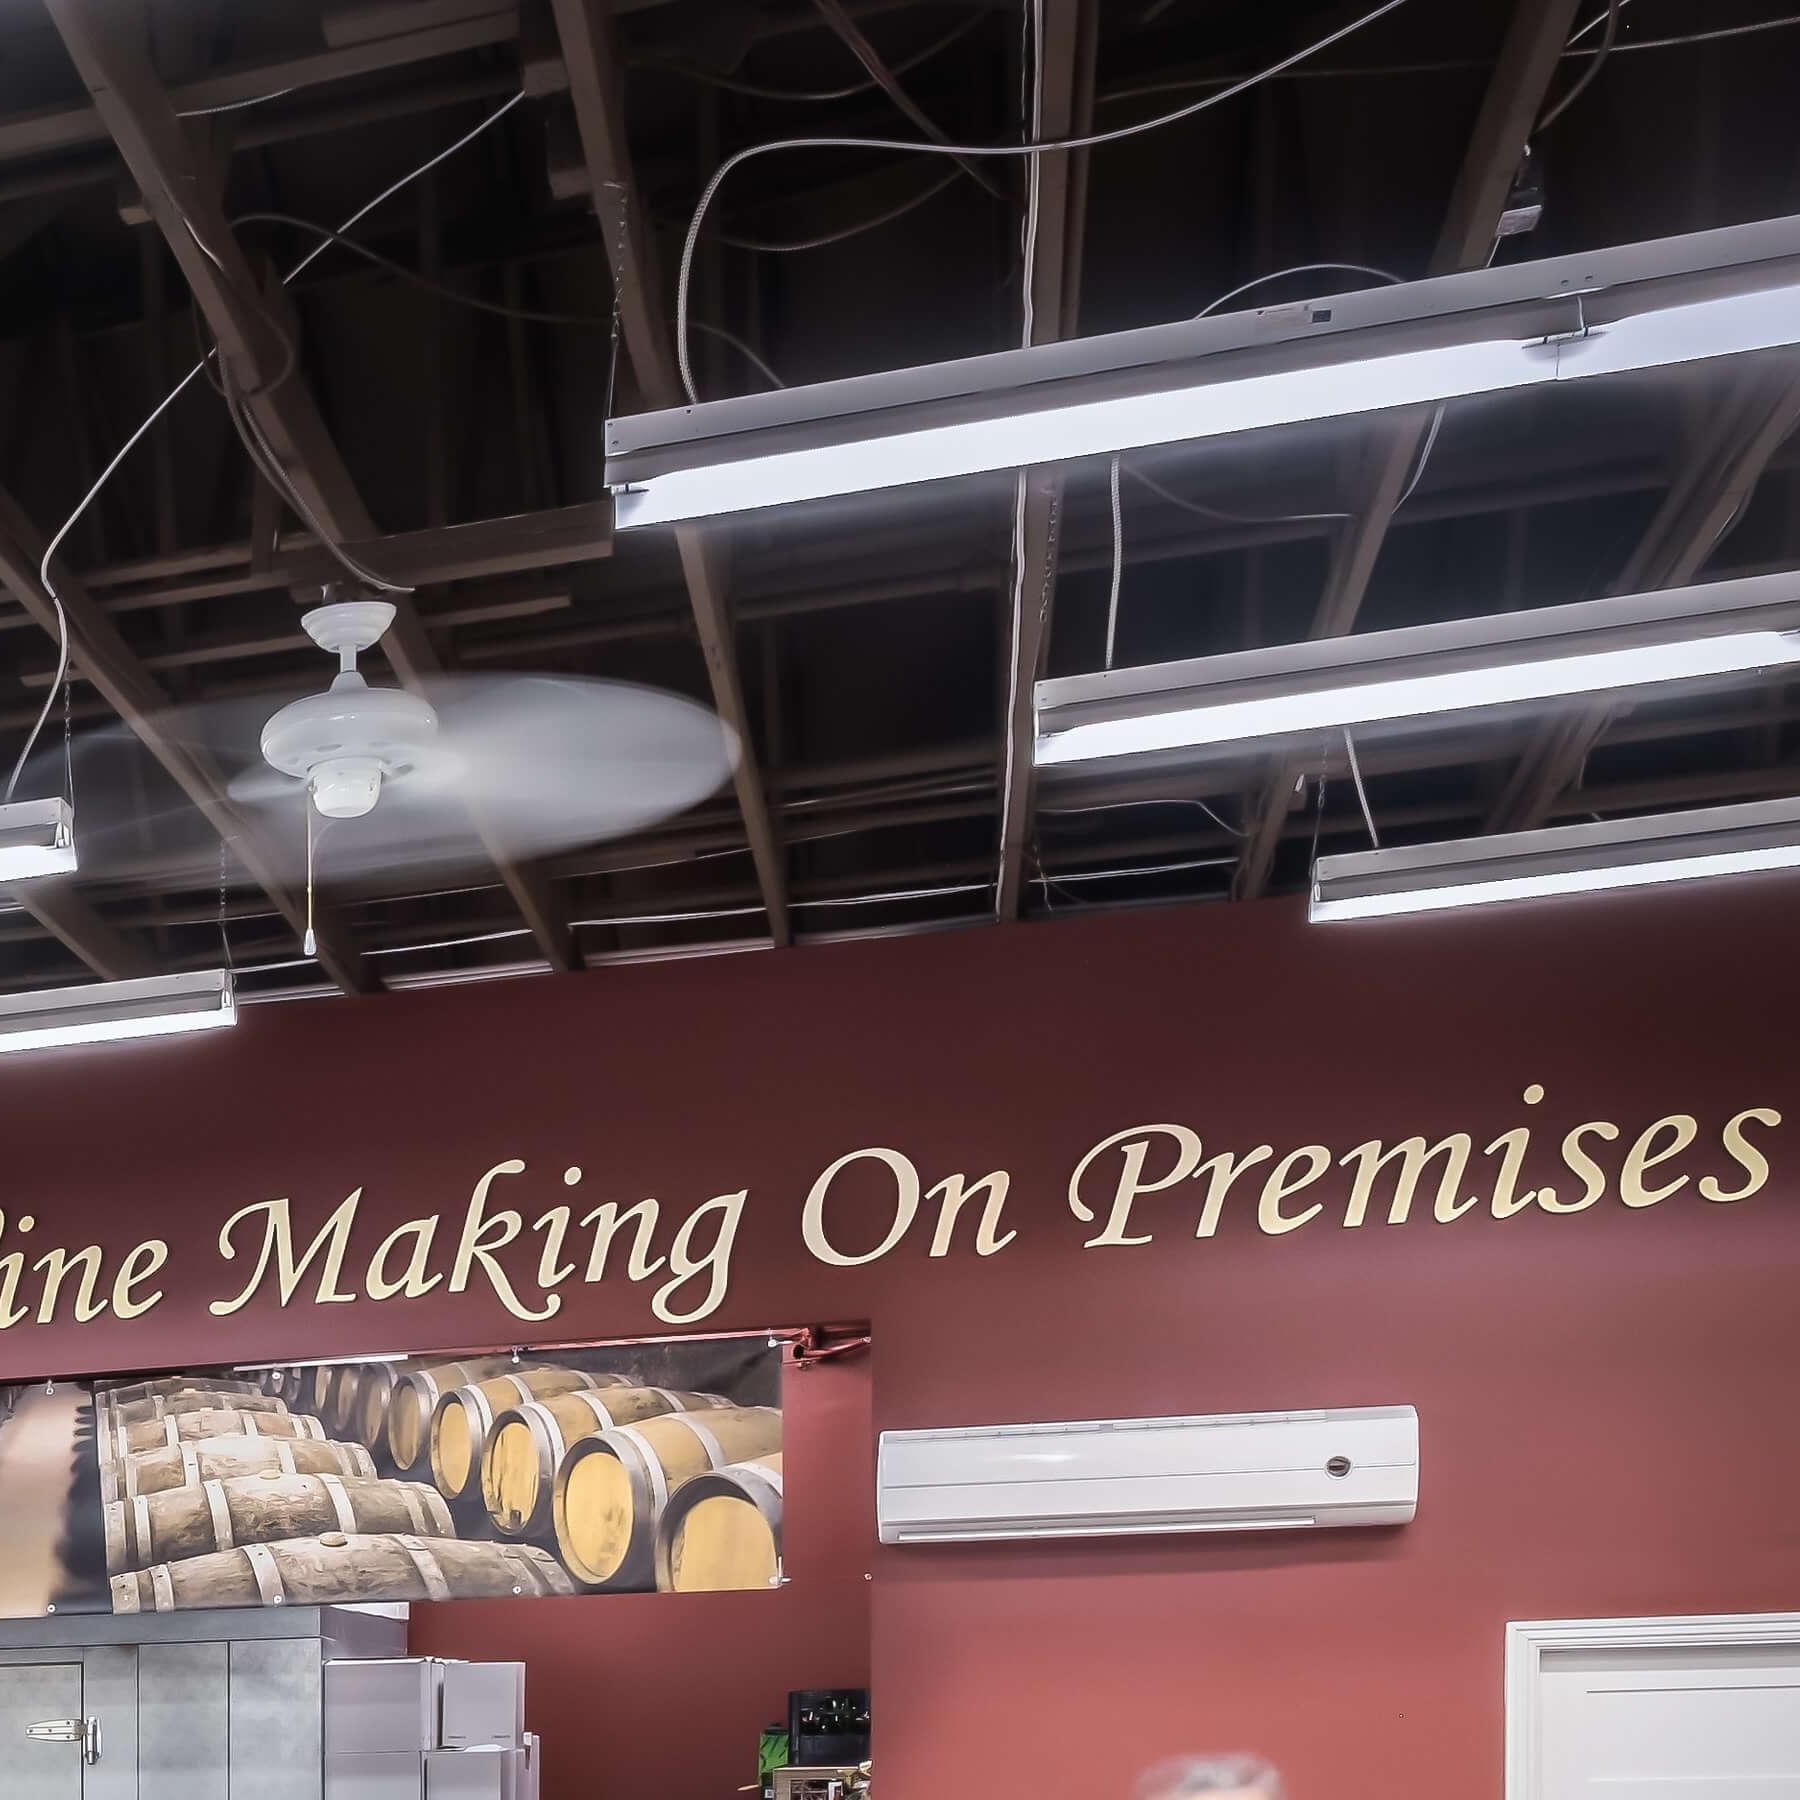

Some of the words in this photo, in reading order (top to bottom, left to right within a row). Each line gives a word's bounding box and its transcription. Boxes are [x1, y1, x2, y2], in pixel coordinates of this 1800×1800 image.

[207, 1158, 750, 1324] Making
[800, 1147, 1018, 1267] On
[1067, 1084, 1783, 1250] Premises
